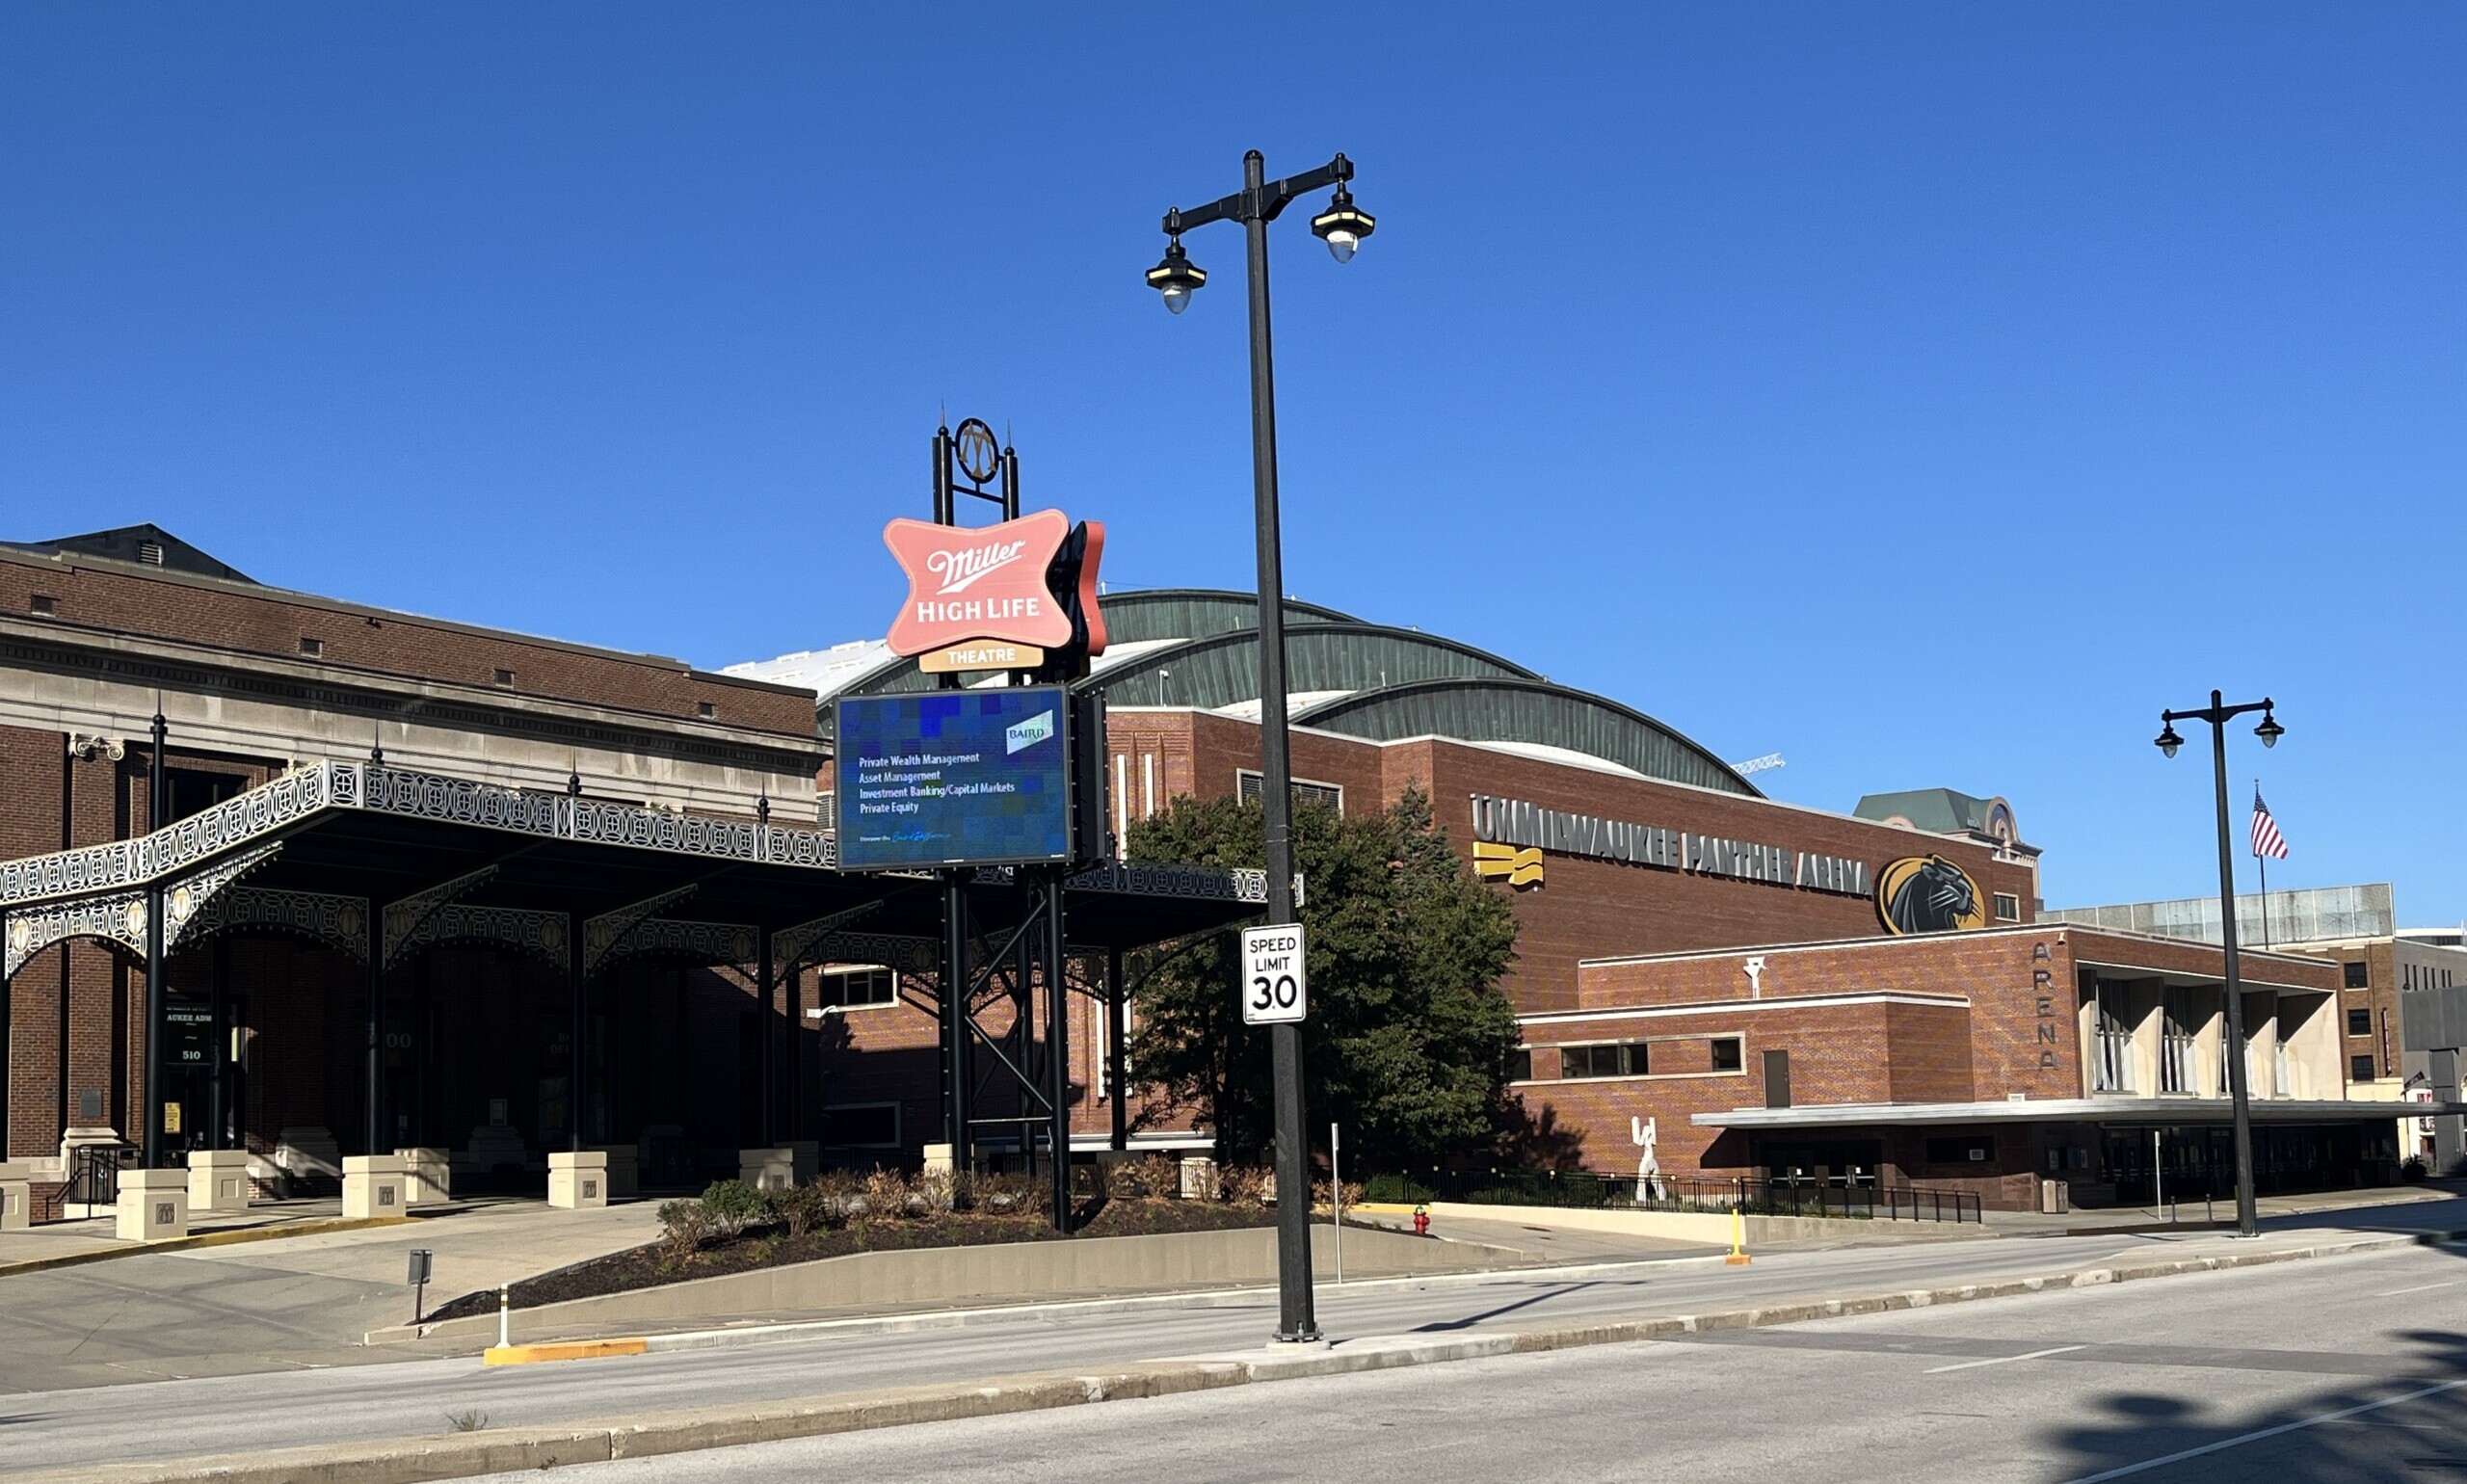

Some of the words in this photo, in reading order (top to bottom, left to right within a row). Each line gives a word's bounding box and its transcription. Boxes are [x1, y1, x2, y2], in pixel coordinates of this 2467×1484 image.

[927, 540, 1025, 589] Miller
[917, 600, 981, 623] HIGH
[987, 597, 1040, 619] LIFE
[947, 648, 1016, 665] THEATRE
[1009, 729, 1045, 740] BAIRD
[859, 756, 889, 768] Private
[890, 755, 920, 766] Wealth
[922, 753, 980, 766] Management
[859, 773, 882, 783] Asset
[884, 770, 941, 783] Management
[860, 788, 908, 799] Investment
[910, 782, 978, 798] Banking/Capital
[980, 782, 1016, 794] Markets
[860, 803, 889, 814] Private
[890, 802, 919, 814] Equity
[1682, 833, 1794, 884] PANTHER
[1795, 852, 1873, 898] ARENA
[1250, 937, 1296, 953] SPEED
[1256, 957, 1290, 972] LIMIT
[1252, 974, 1297, 1011] 30
[2032, 941, 2059, 1072] ARENA
[385, 1032, 411, 1048] 00
[182, 1049, 201, 1060] 510
